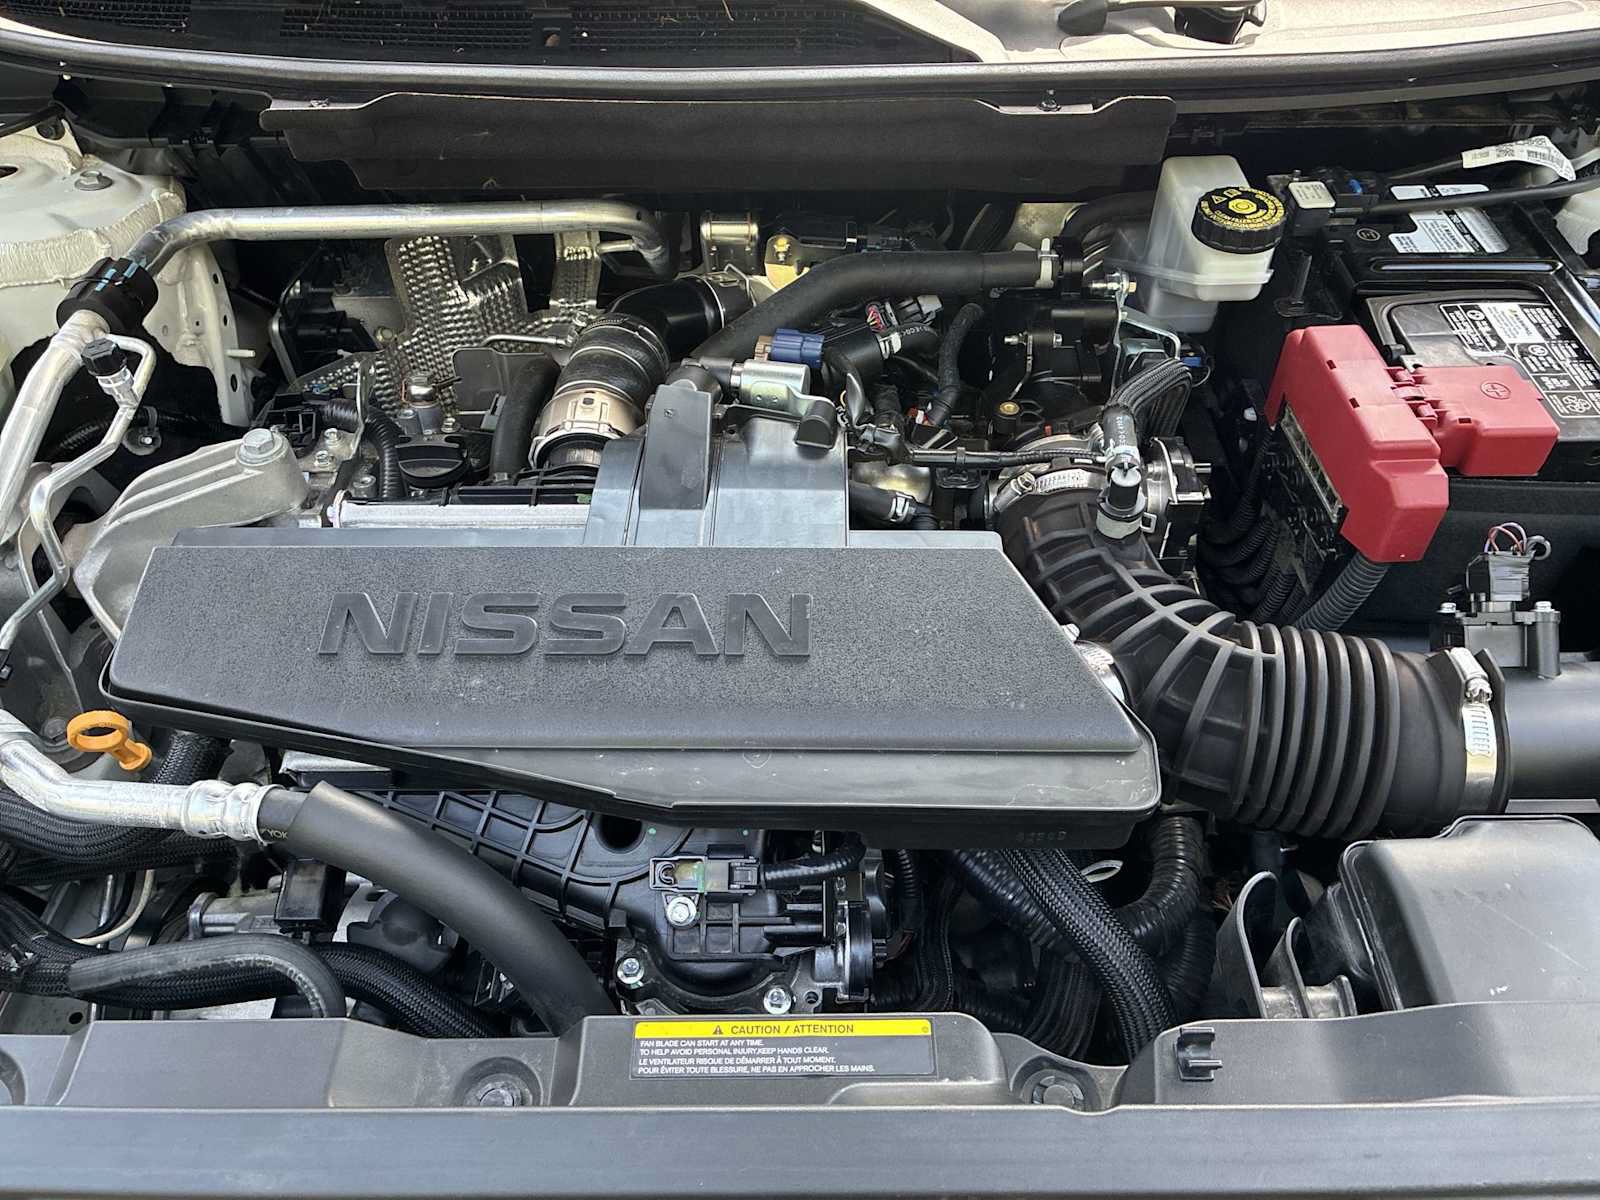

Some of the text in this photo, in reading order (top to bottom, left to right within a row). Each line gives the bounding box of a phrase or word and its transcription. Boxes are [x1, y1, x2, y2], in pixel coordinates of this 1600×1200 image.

[318, 592, 814, 657] NISSAN
[730, 1024, 854, 1035] CAUTION / ATTENTION
[736, 1057, 775, 1065] DÉMARRER
[776, 1056, 781, 1064] À
[638, 1066, 659, 1074] POUR
[661, 1065, 685, 1074] ÉVITER
[686, 1066, 709, 1074] TOUTE
[710, 1066, 750, 1074] BLESSURE,
[751, 1066, 761, 1074] NE
[762, 1066, 776, 1074] PAS
